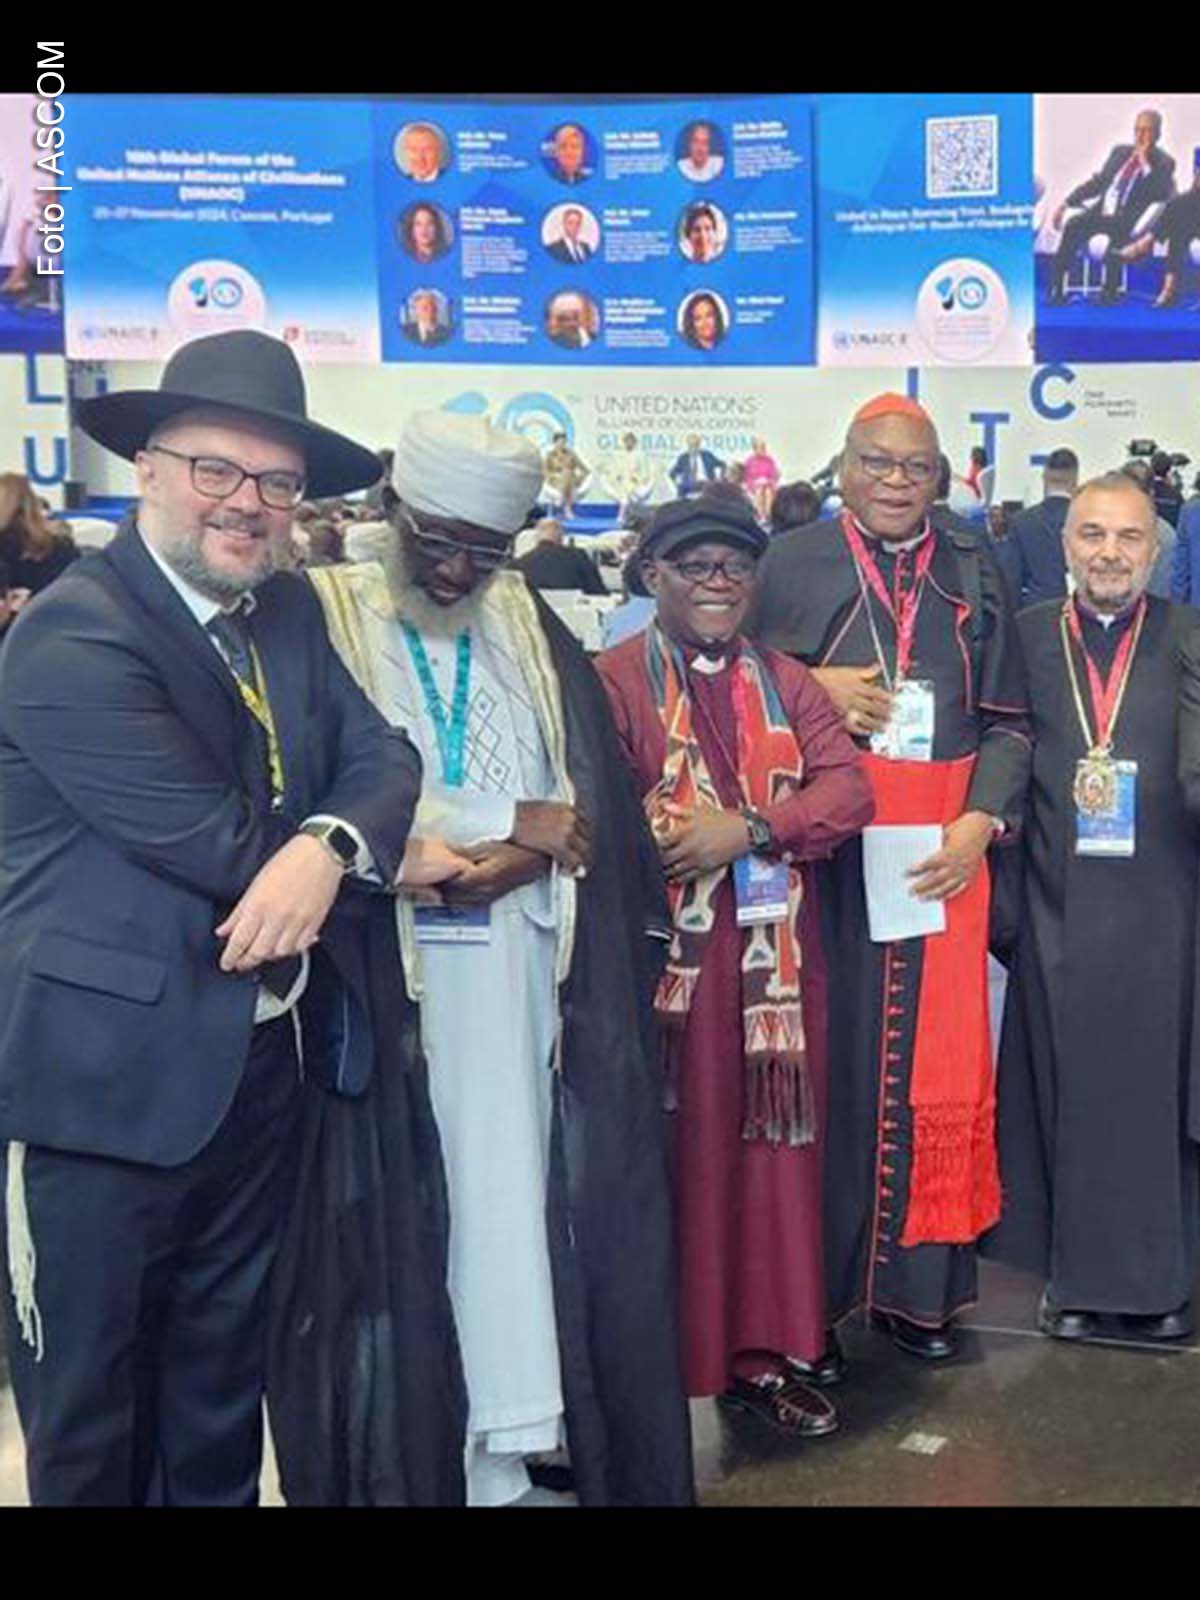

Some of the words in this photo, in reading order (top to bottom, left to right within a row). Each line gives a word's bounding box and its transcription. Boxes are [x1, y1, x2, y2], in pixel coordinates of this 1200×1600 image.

[595, 395, 671, 414] UNITED
[673, 396, 757, 415] NATIONS
[597, 433, 679, 451] GLBAL
